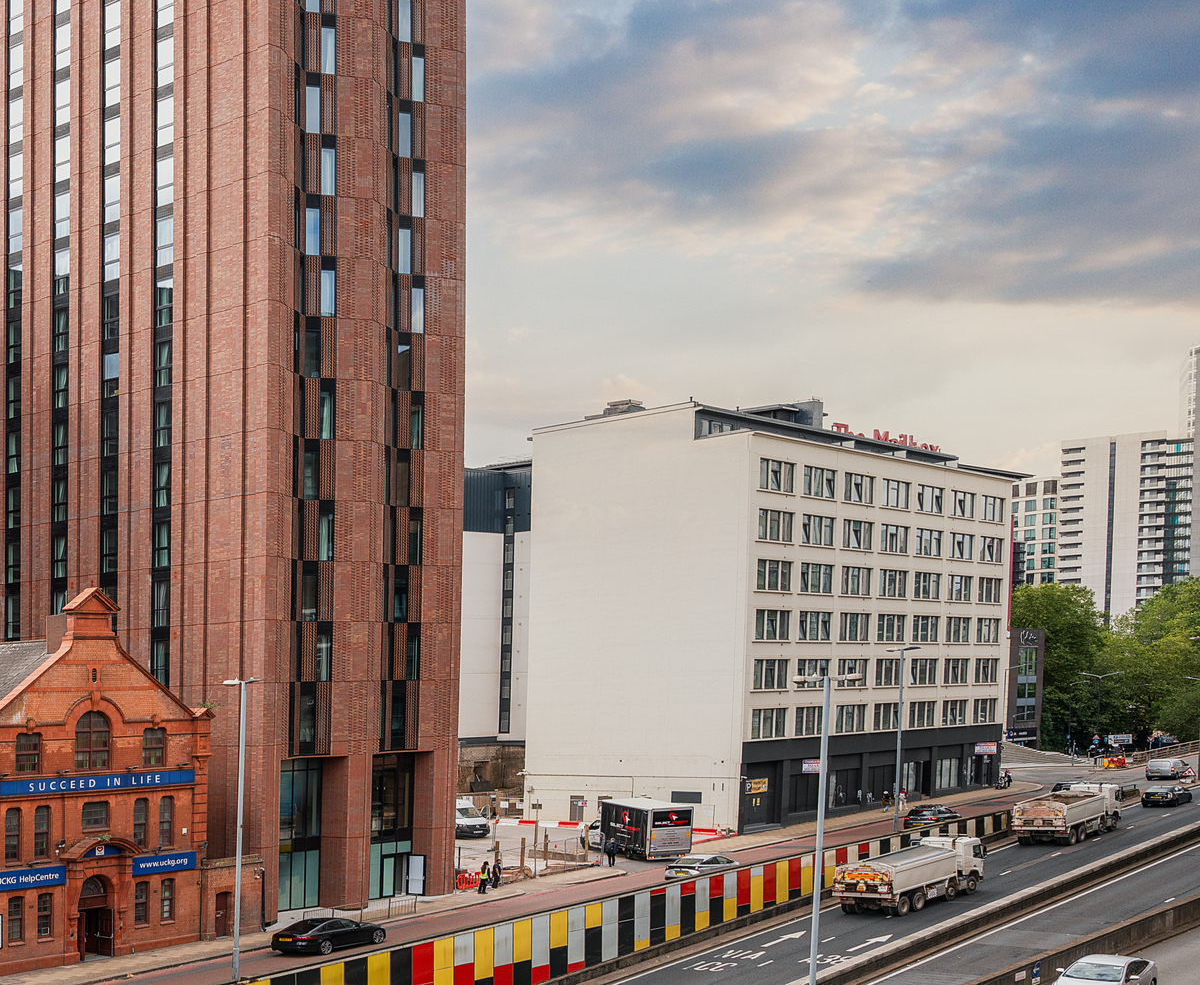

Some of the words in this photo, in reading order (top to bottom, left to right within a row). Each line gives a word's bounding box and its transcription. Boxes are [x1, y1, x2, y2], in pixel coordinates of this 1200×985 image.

[29, 778, 97, 792] SUCCEED
[107, 777, 121, 787] IN
[131, 774, 161, 785] LIFE
[139, 857, 188, 870] www.uckg.org
[19, 872, 60, 884] HelpCentre
